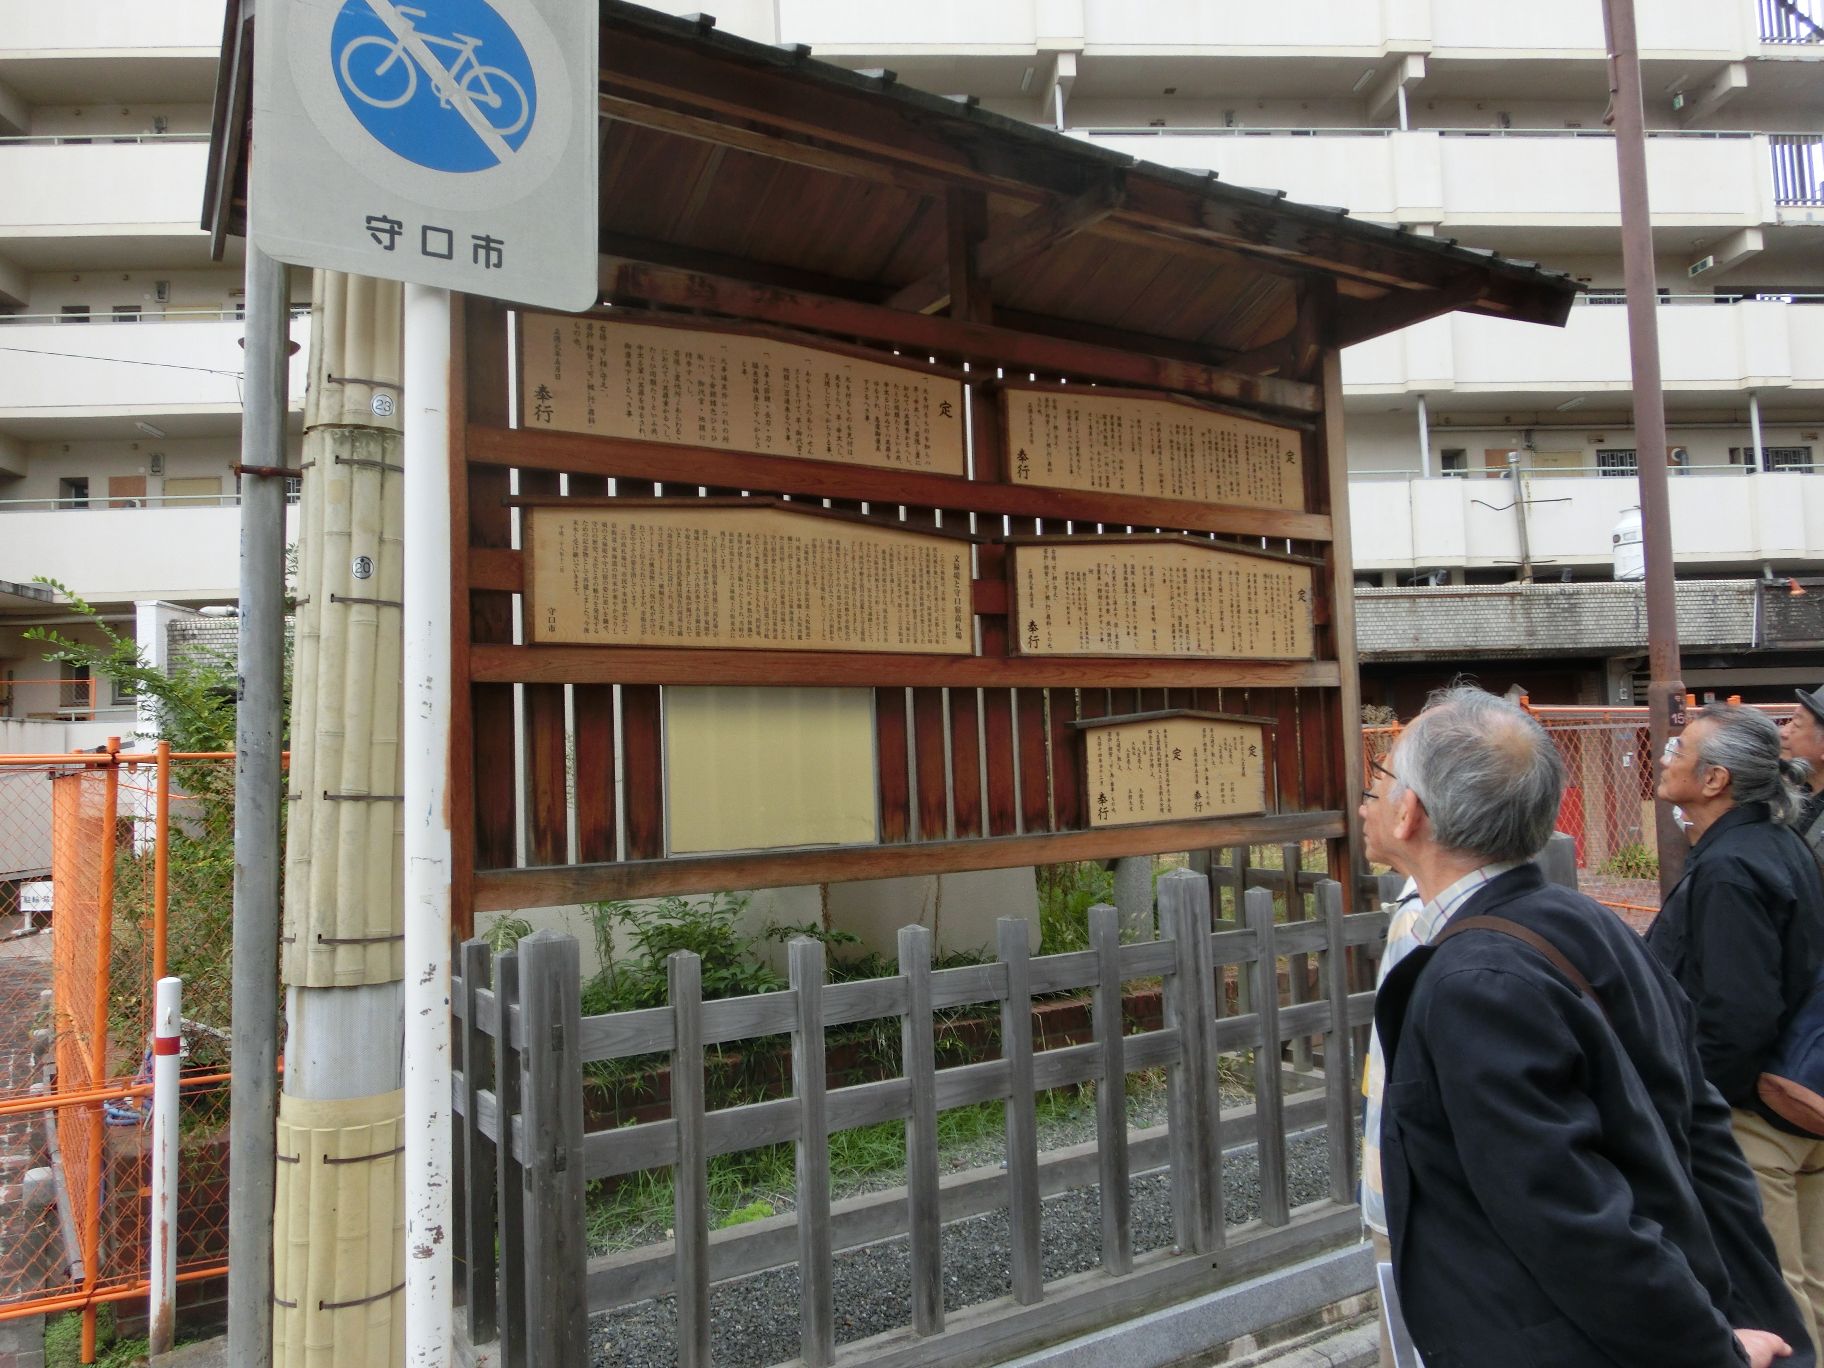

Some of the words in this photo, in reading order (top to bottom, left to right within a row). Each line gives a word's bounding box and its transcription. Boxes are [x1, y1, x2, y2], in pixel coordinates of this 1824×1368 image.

[365, 214, 505, 269] 守口市
[375, 399, 391, 412] 23
[534, 384, 554, 423] 奉行
[939, 400, 953, 418] 定
[1016, 448, 1031, 480] 奉行
[1285, 450, 1296, 465] 定
[1296, 588, 1307, 603] 定
[547, 607, 556, 633] 守口市
[1027, 619, 1040, 649] 奉行
[1671, 713, 1685, 725] 15
[1172, 747, 1183, 761] 定
[1248, 744, 1258, 758] 定
[1097, 792, 1109, 821] 奉行
[1194, 790, 1203, 813] 奉行
